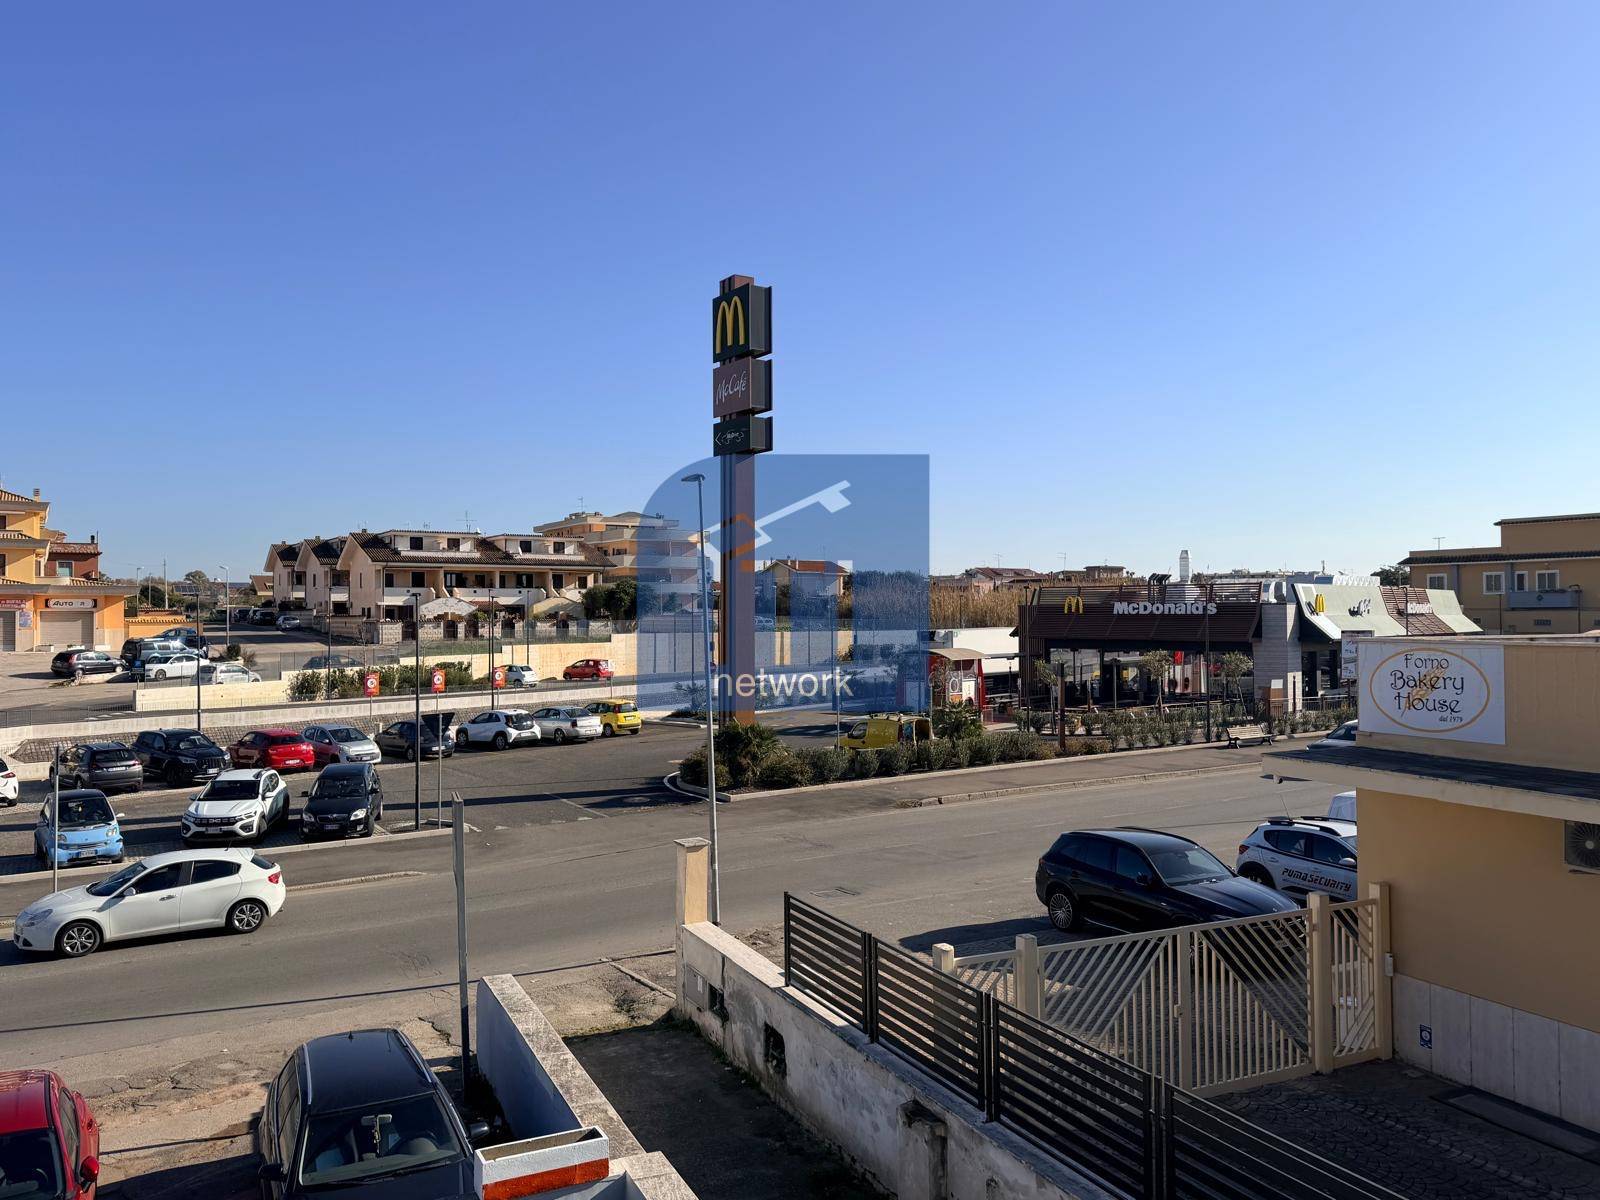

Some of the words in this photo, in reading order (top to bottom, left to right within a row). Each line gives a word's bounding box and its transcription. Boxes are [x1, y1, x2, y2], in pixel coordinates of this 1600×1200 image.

[1113, 602, 1217, 615] McDonald's
[1404, 652, 1449, 669] Forno
[1390, 669, 1464, 695] Bakery
[1394, 692, 1461, 714] House
